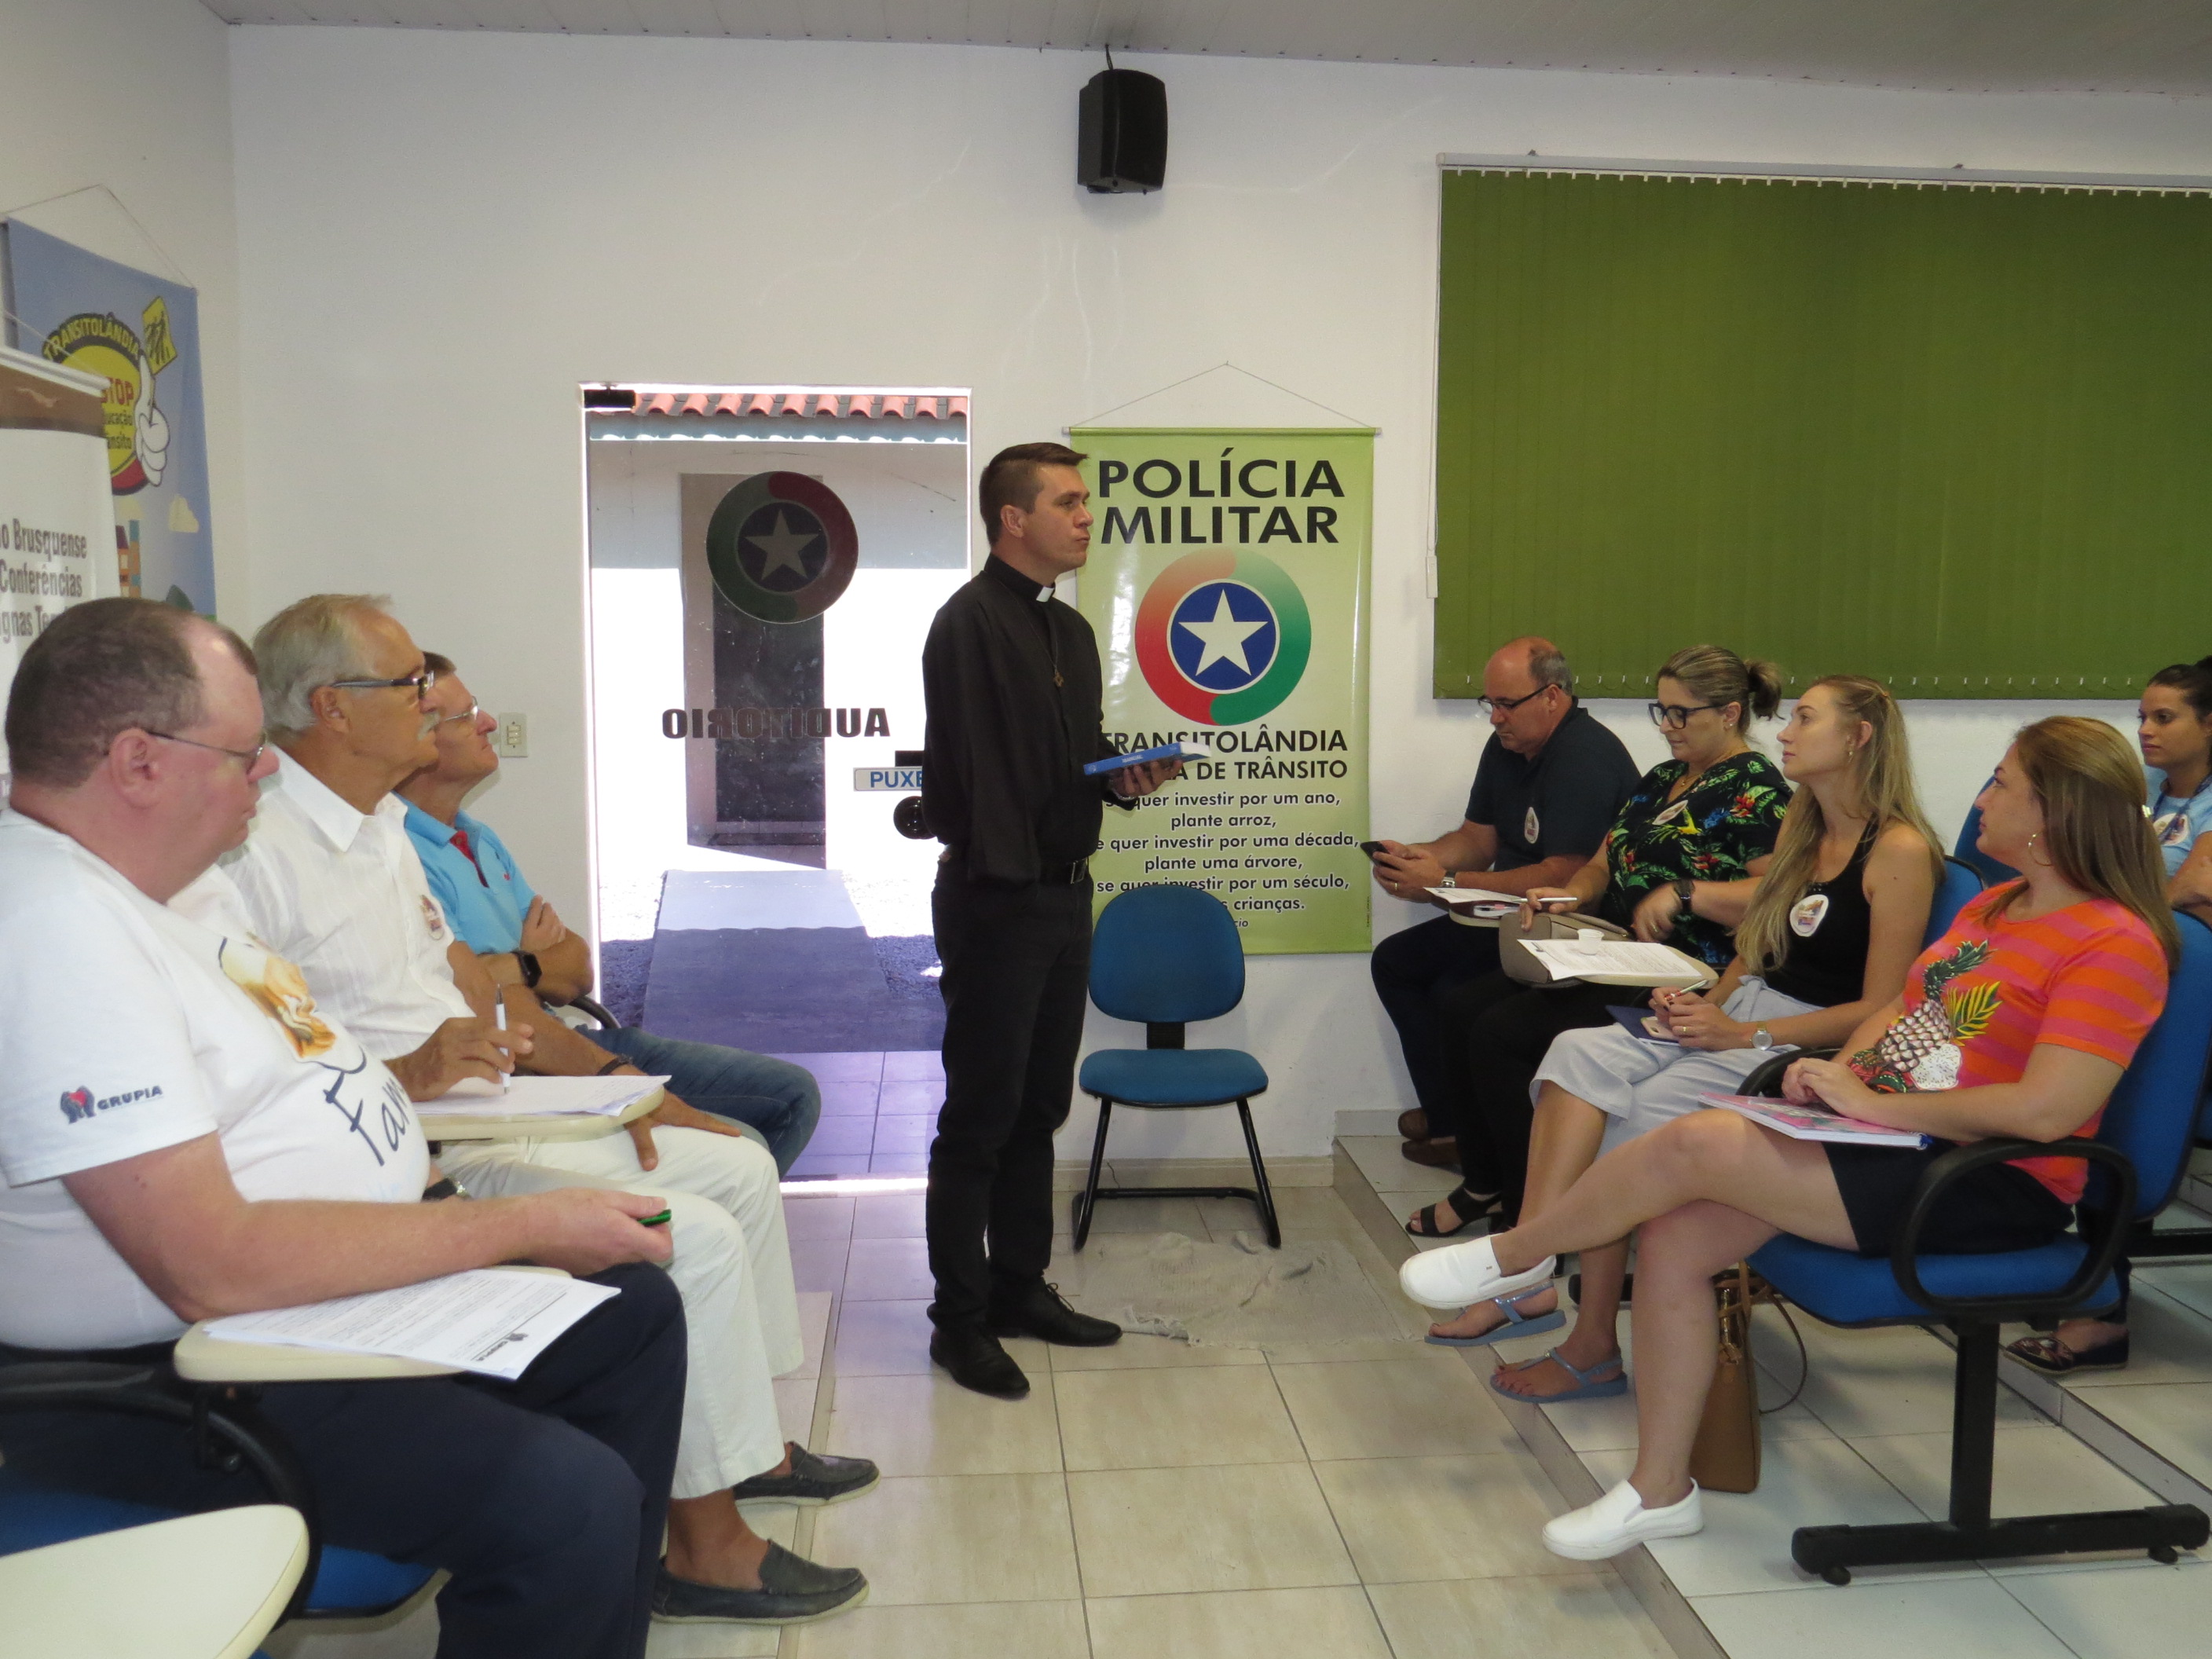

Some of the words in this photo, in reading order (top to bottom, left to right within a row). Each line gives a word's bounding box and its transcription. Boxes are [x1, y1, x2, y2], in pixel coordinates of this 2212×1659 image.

[1100, 447, 1345, 499] POLÍCIA
[1101, 506, 1339, 544] MILITAR
[13, 518, 87, 562] Brusquense
[0, 558, 82, 597] Conferências
[1197, 763, 1225, 780] DE
[1235, 756, 1348, 780] TRÂNSITO
[1174, 792, 1234, 807] investir
[1240, 794, 1268, 808] por
[1273, 793, 1298, 804] um
[1305, 793, 1341, 806] ano,
[1171, 813, 1223, 830] plante
[1229, 815, 1276, 829] arroz,
[1111, 839, 1149, 852] quer
[1155, 834, 1214, 849] investir
[1220, 837, 1247, 851] por
[1253, 836, 1289, 847] uma
[1295, 831, 1359, 848] década,
[1145, 855, 1196, 873] plante
[1203, 859, 1239, 870] uma
[1244, 855, 1303, 870] árvore,
[1097, 881, 1115, 892] se
[1229, 879, 1256, 893] por
[1262, 877, 1288, 888] um
[1293, 873, 1350, 890] século,
[1233, 896, 1306, 913] crianças.
[97, 1085, 163, 1110] GRUPIA
